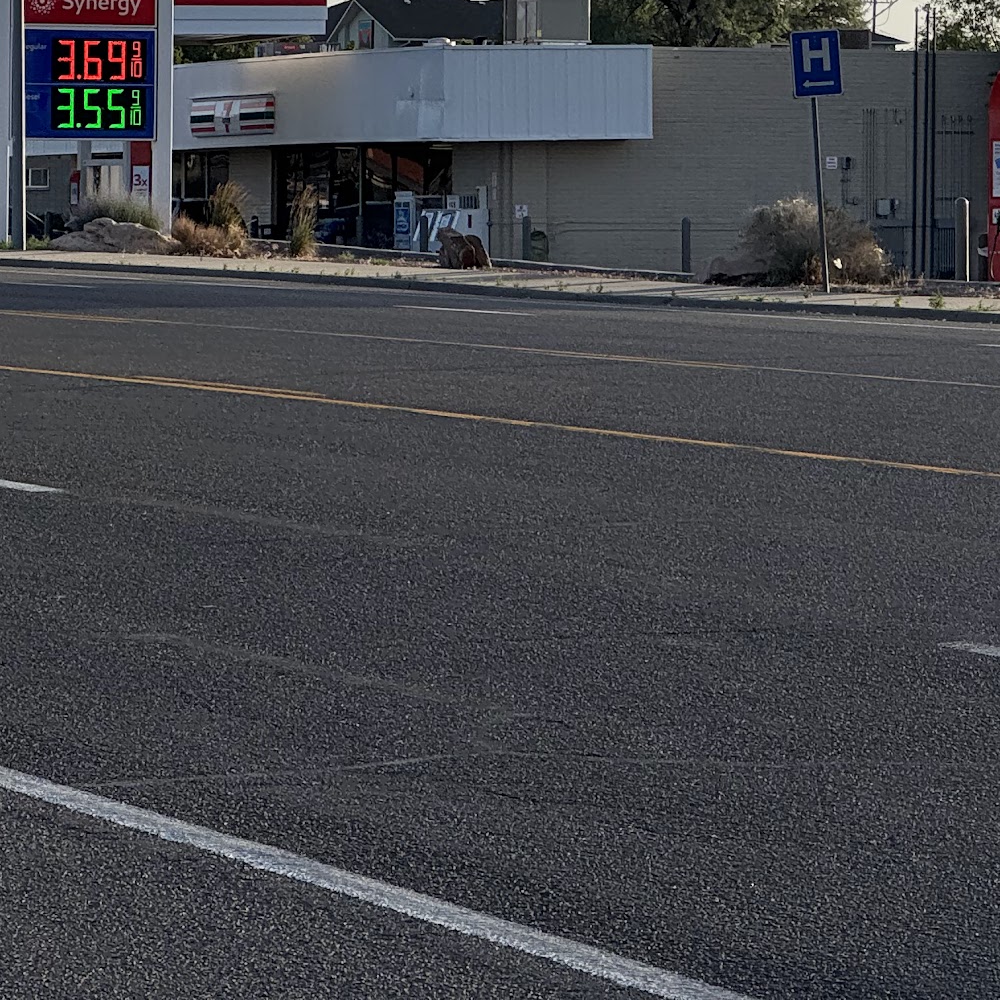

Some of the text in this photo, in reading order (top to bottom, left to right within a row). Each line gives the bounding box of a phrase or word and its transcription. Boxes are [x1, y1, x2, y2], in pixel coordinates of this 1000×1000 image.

[26, 43, 47, 51] egular
[57, 40, 126, 80] 3.69
[801, 37, 831, 73] H
[57, 88, 126, 129] 3.55
[134, 174, 148, 187] 3x
